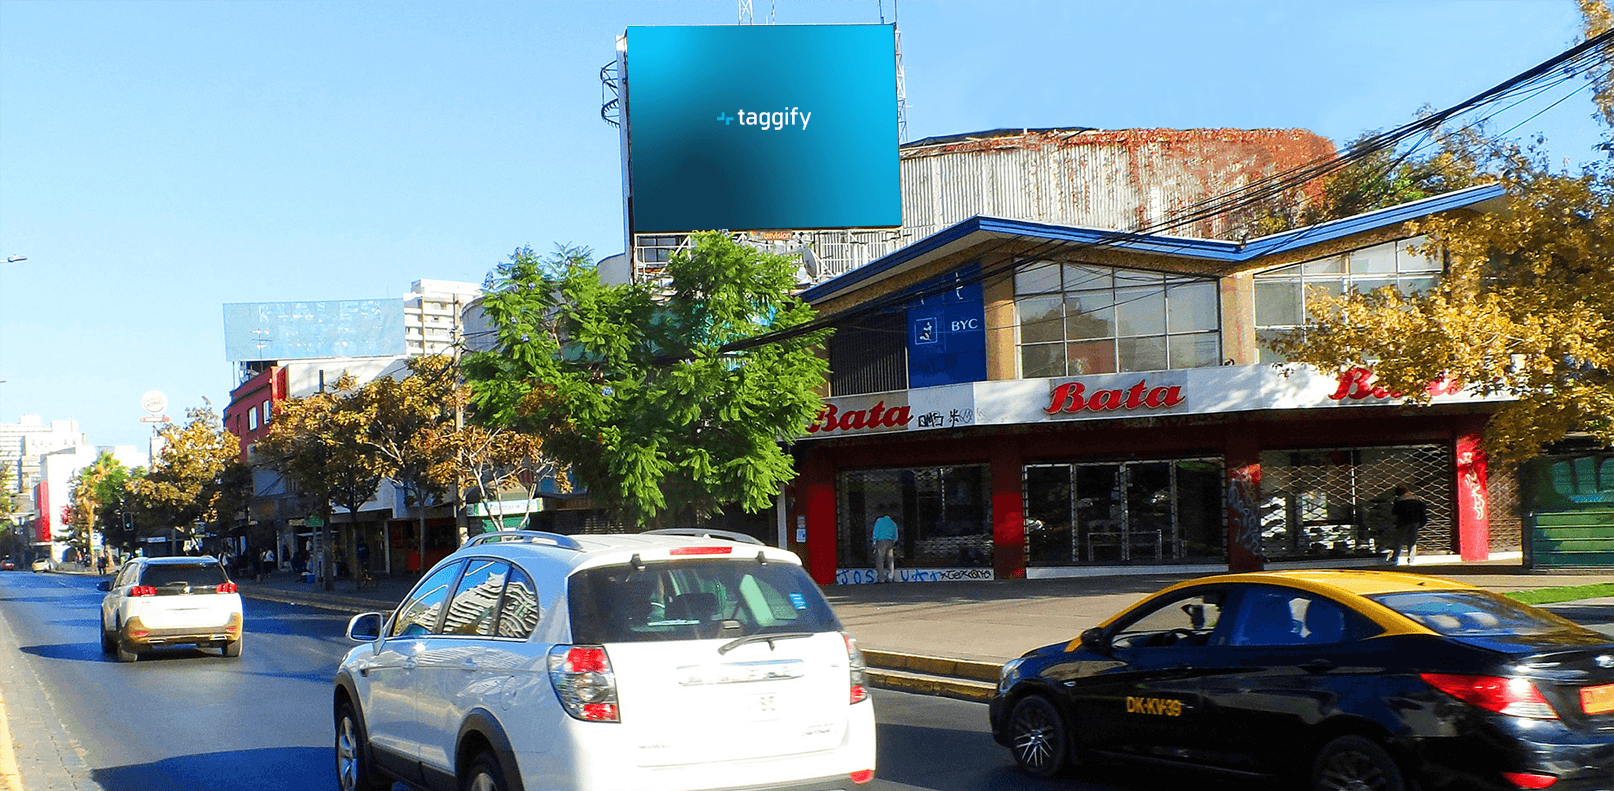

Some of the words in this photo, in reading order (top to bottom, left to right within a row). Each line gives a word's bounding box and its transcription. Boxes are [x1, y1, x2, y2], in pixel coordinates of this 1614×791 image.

[737, 106, 812, 131] taggify
[951, 318, 978, 332] BYC
[1042, 378, 1186, 416] Bata
[806, 400, 914, 433] Bata
[1126, 695, 1182, 716] DK-KV-39
